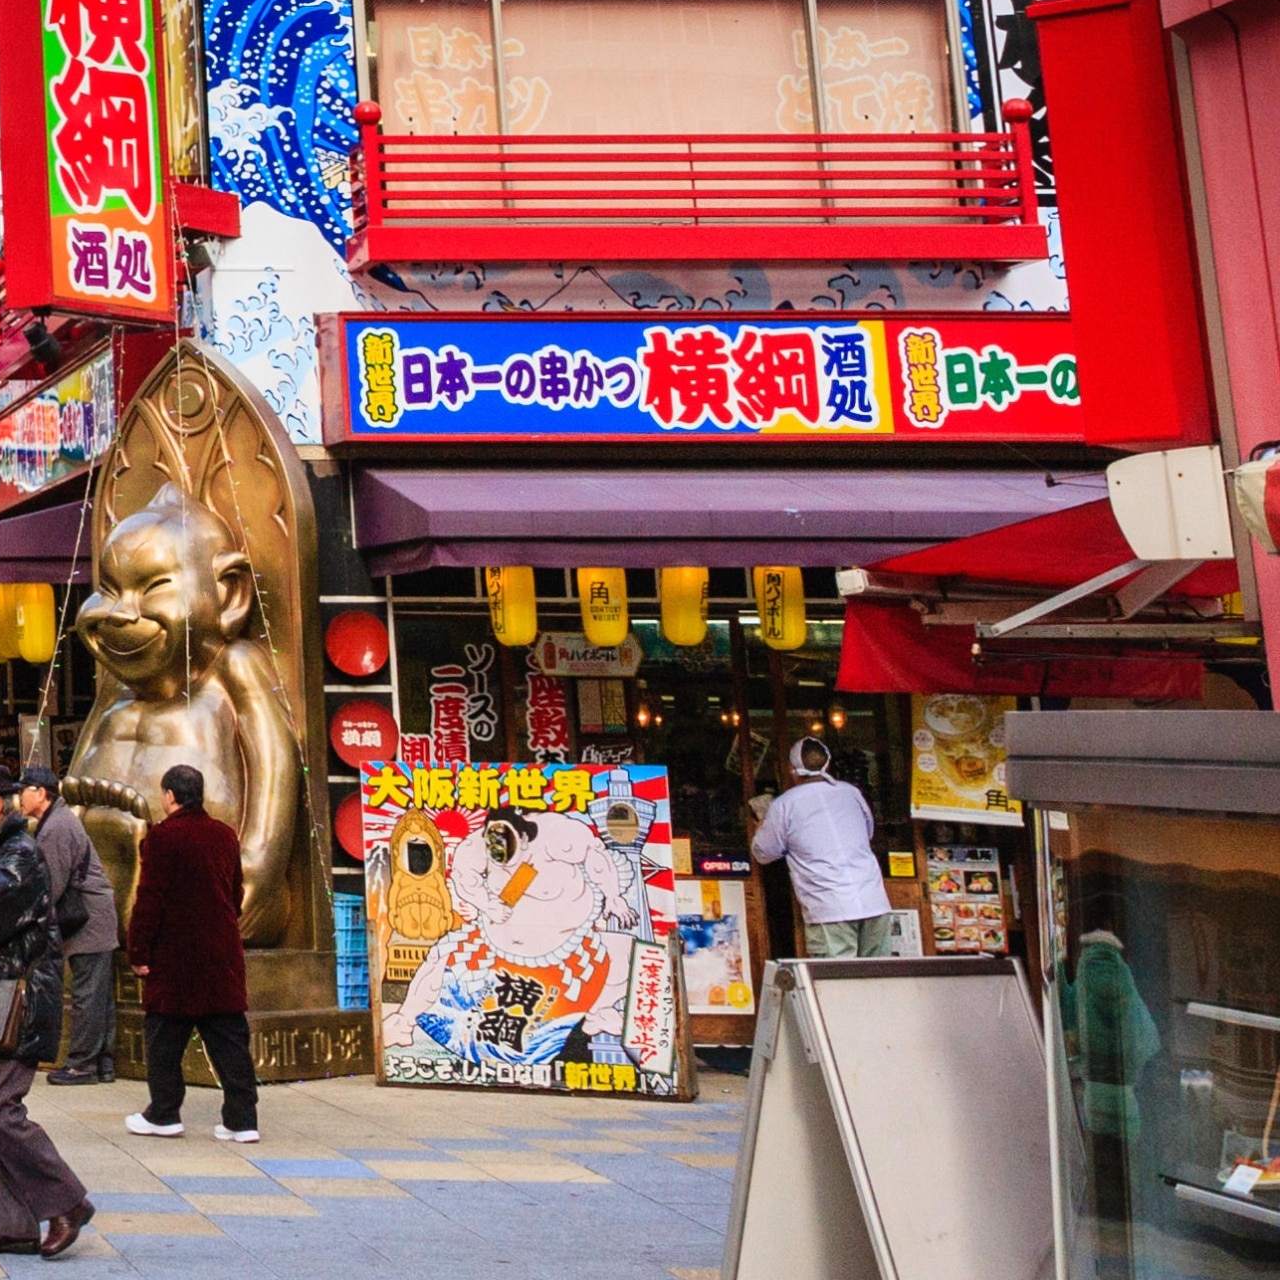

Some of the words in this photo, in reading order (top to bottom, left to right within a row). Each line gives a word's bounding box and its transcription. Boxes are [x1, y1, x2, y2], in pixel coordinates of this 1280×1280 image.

[73, 226, 152, 295] 酒処
[360, 330, 398, 426] 新世界
[402, 349, 637, 406] 日本一の串かつ
[642, 325, 821, 427] 横綱
[822, 332, 875, 425] 酒処
[904, 330, 941, 427] 新世界
[946, 349, 1081, 406] 日本一の
[589, 581, 610, 605] 角
[765, 570, 782, 639] 角ハイボール
[465, 643, 497, 741] ソースの
[367, 766, 599, 812] 大阪新世界
[702, 861, 731, 871] OPEN
[387, 966, 419, 980] THING
[475, 968, 545, 1054] 横綱
